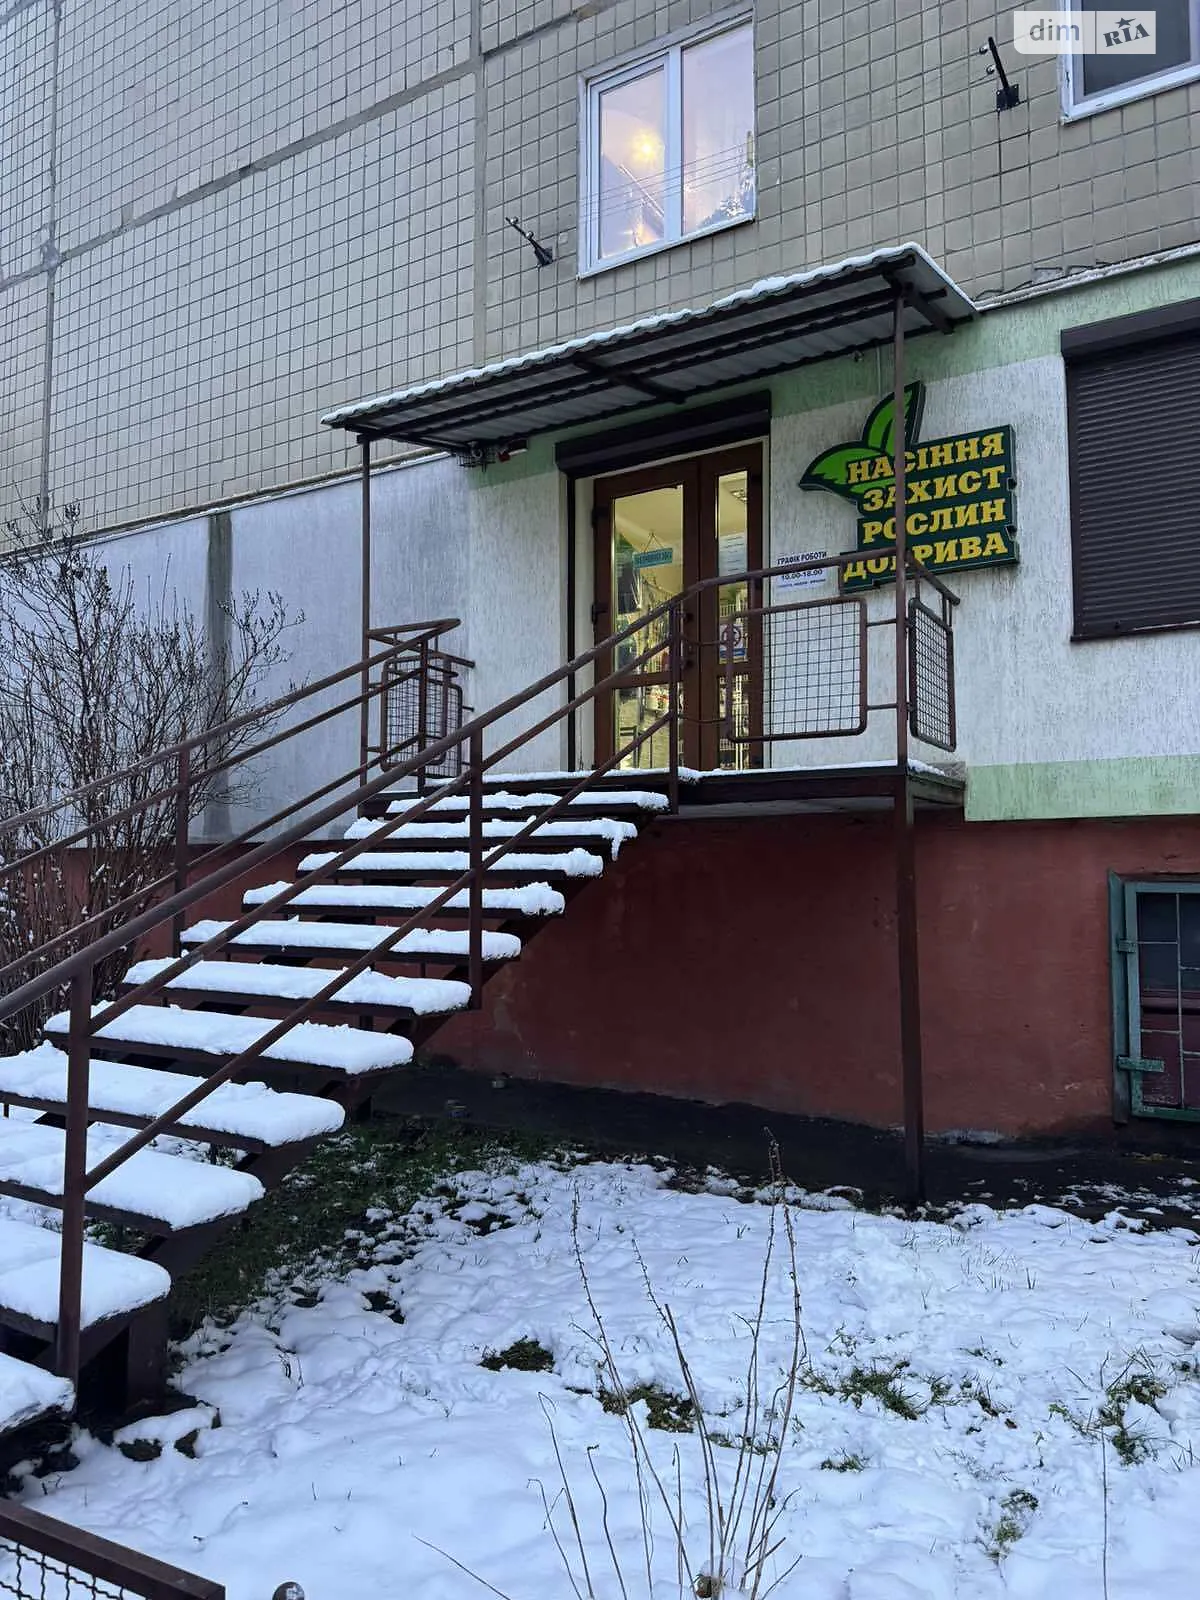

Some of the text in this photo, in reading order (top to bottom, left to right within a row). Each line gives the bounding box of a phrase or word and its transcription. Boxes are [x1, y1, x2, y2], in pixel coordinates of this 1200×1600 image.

[864, 466, 1005, 512] ЗАХИСТ
[863, 498, 1006, 544] РОСЛИН
[777, 551, 827, 571] ГРАФІК РОБОТИ
[844, 532, 1007, 582] ДОРИВА
